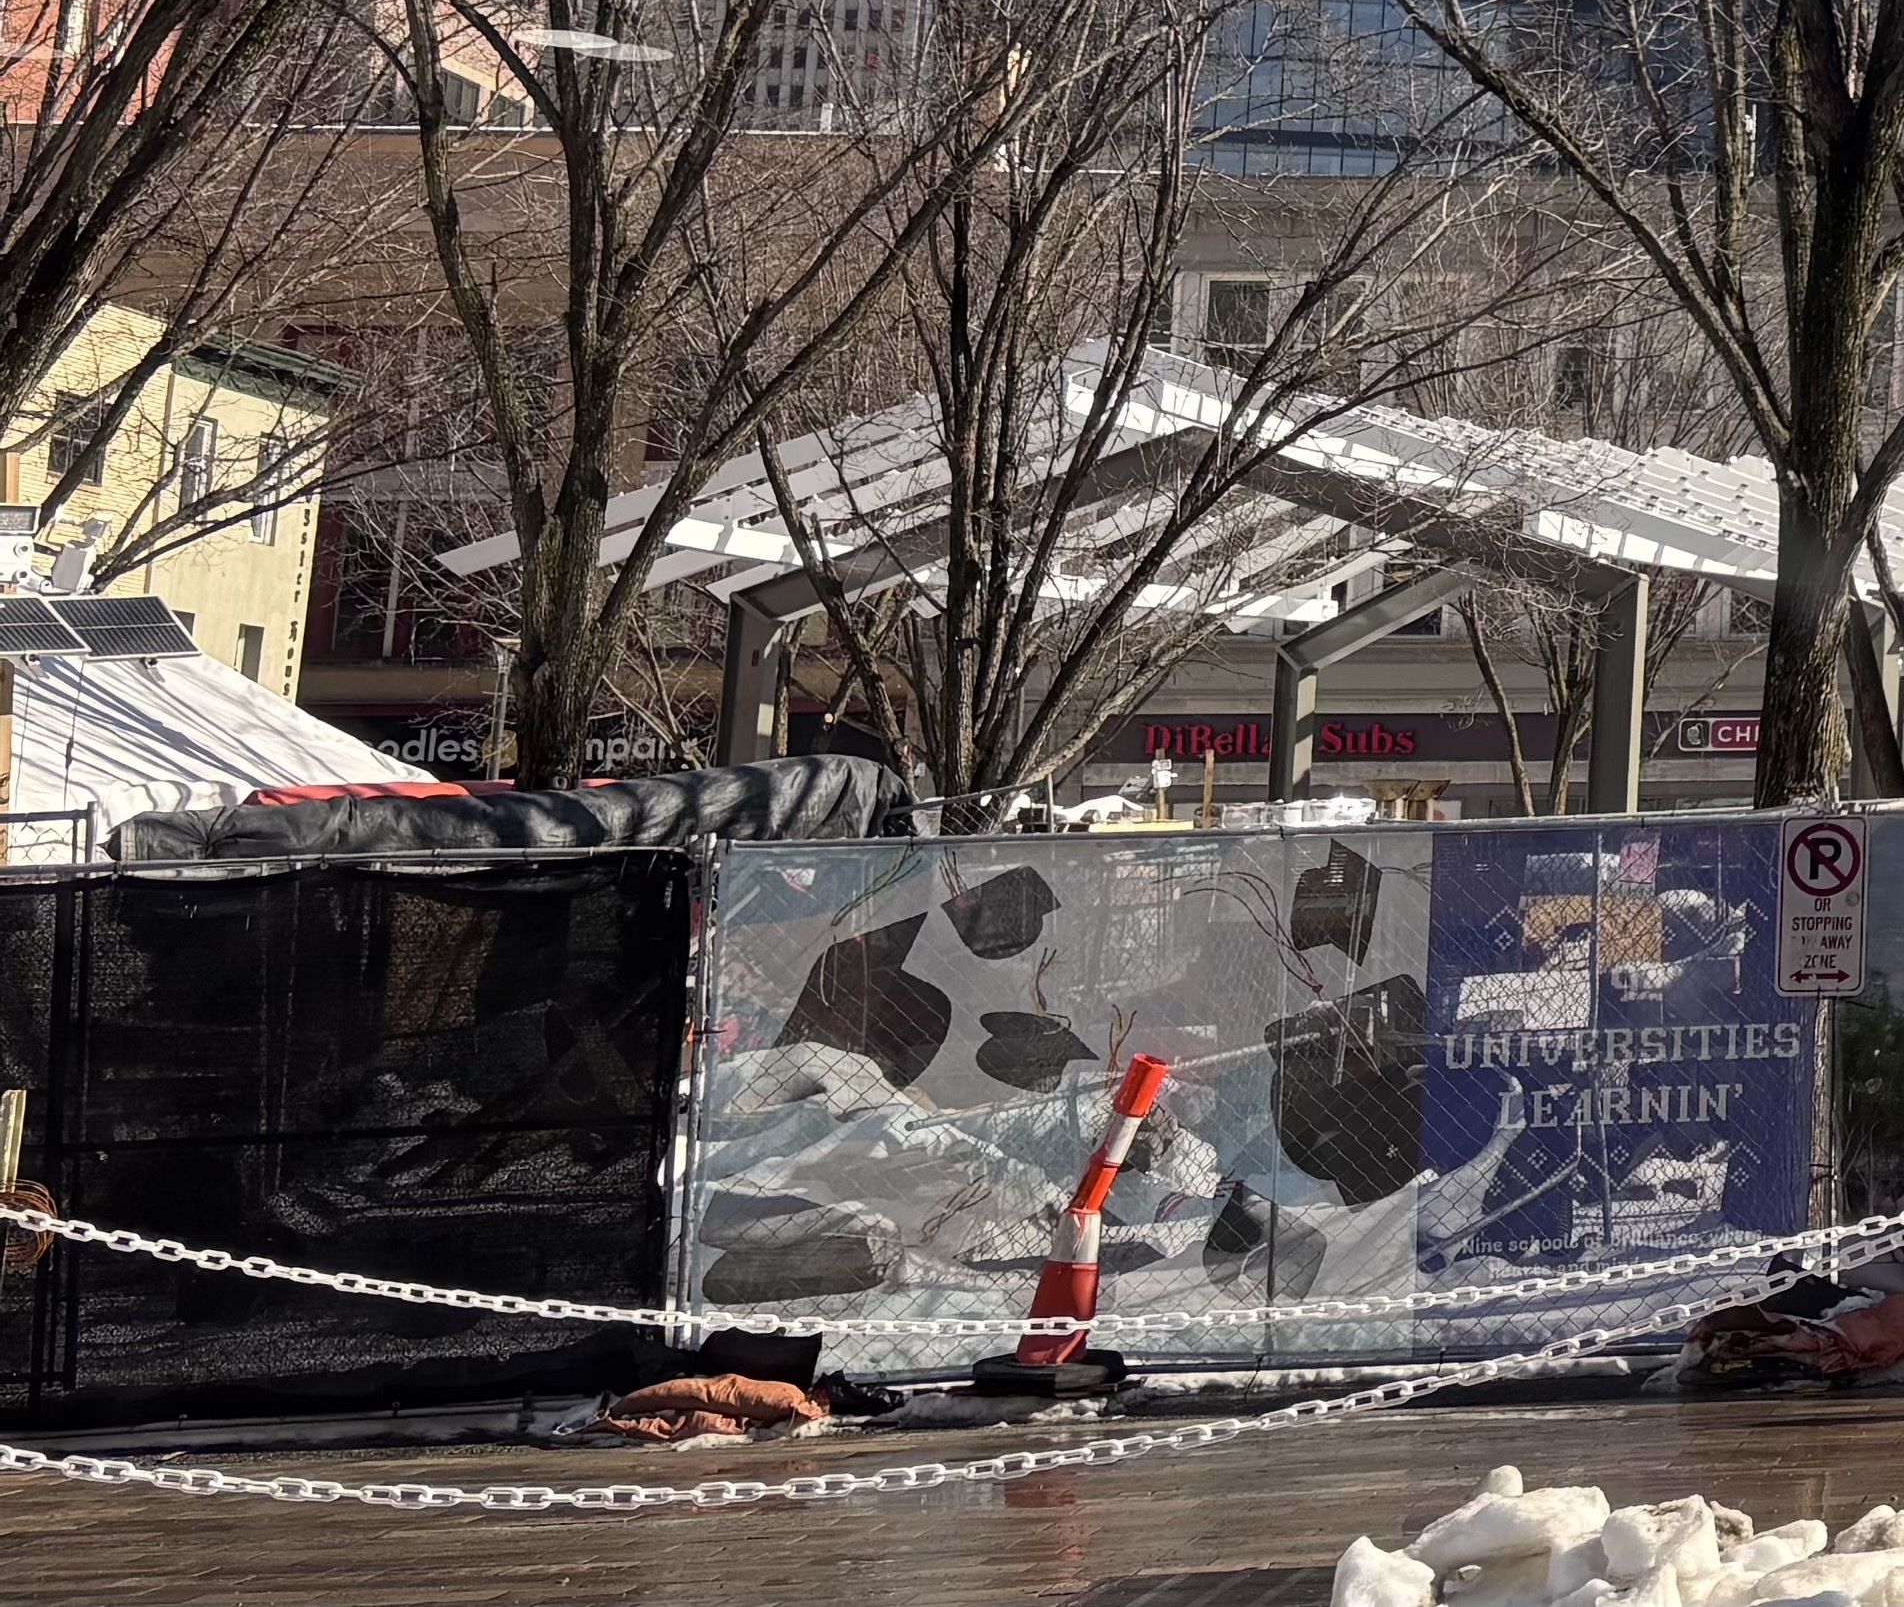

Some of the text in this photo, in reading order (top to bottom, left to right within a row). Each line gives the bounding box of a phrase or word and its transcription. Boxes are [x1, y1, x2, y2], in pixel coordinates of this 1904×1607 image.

[1319, 722, 1416, 755] Subs
[1717, 725, 1761, 744] CHI
[1814, 897, 1831, 912] OR
[1792, 916, 1853, 931] STOPPING
[1820, 935, 1853, 949] AWAY
[1444, 1023, 1800, 1070] UNIVERSITIES
[1498, 1084, 1743, 1129] LEARNIN'
[1462, 1239, 1503, 1255] Nine
